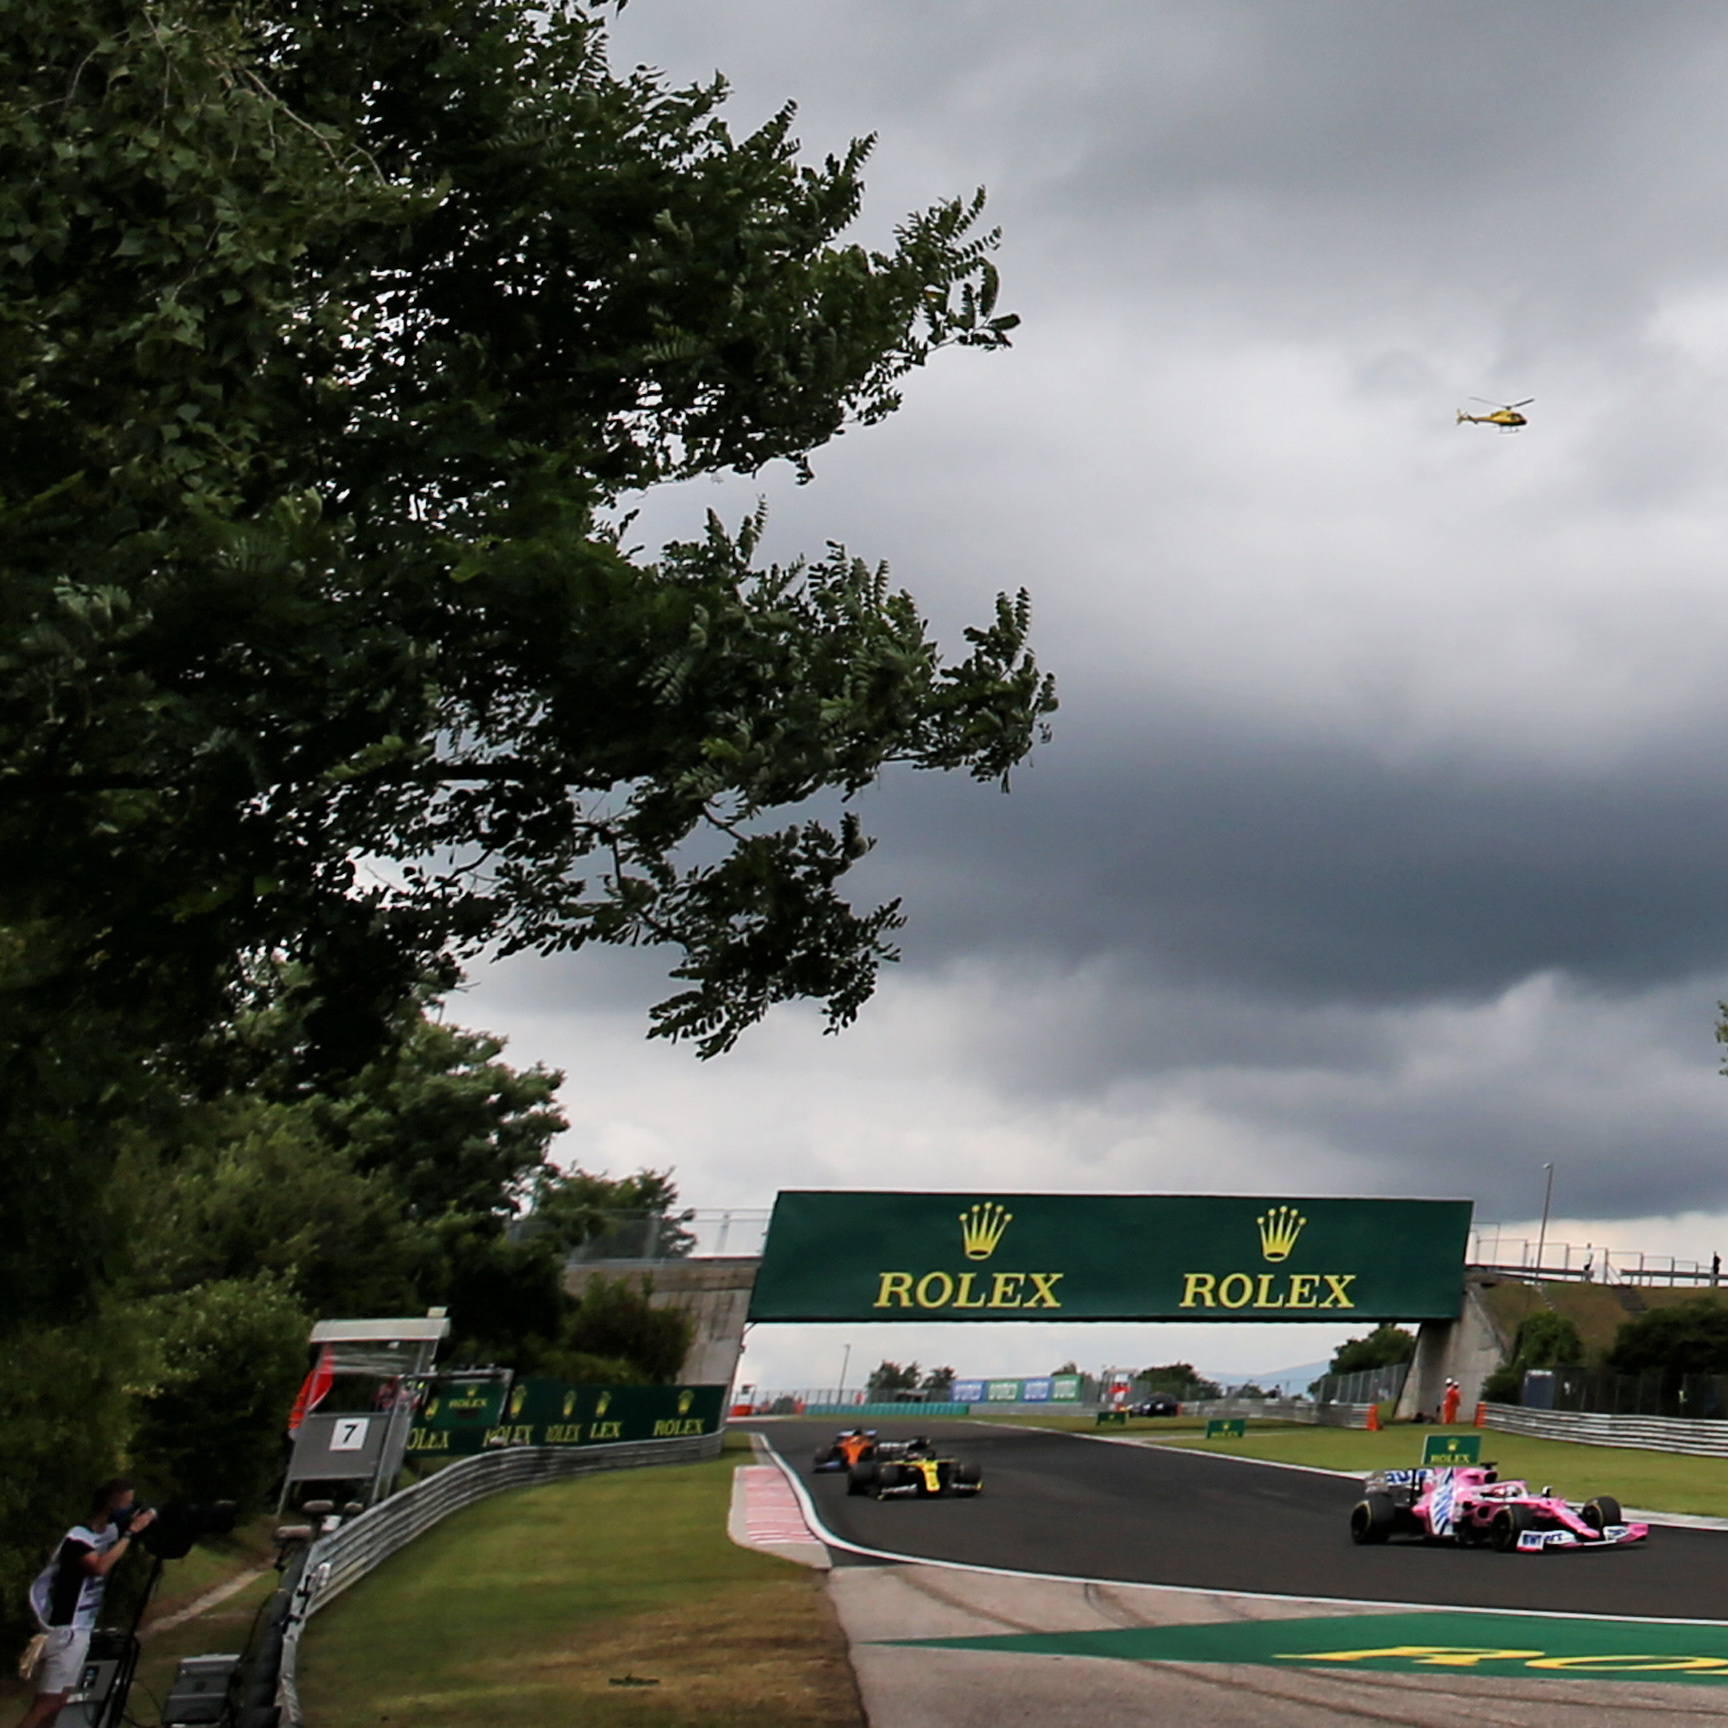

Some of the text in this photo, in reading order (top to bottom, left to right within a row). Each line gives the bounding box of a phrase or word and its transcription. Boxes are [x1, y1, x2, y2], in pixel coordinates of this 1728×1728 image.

[873, 1271, 1064, 1309] ROLEX
[1179, 1272, 1356, 1309] ROLEX
[343, 1424, 359, 1443] 7
[652, 1419, 704, 1436] ROLEX
[406, 1428, 449, 1450] OLEX
